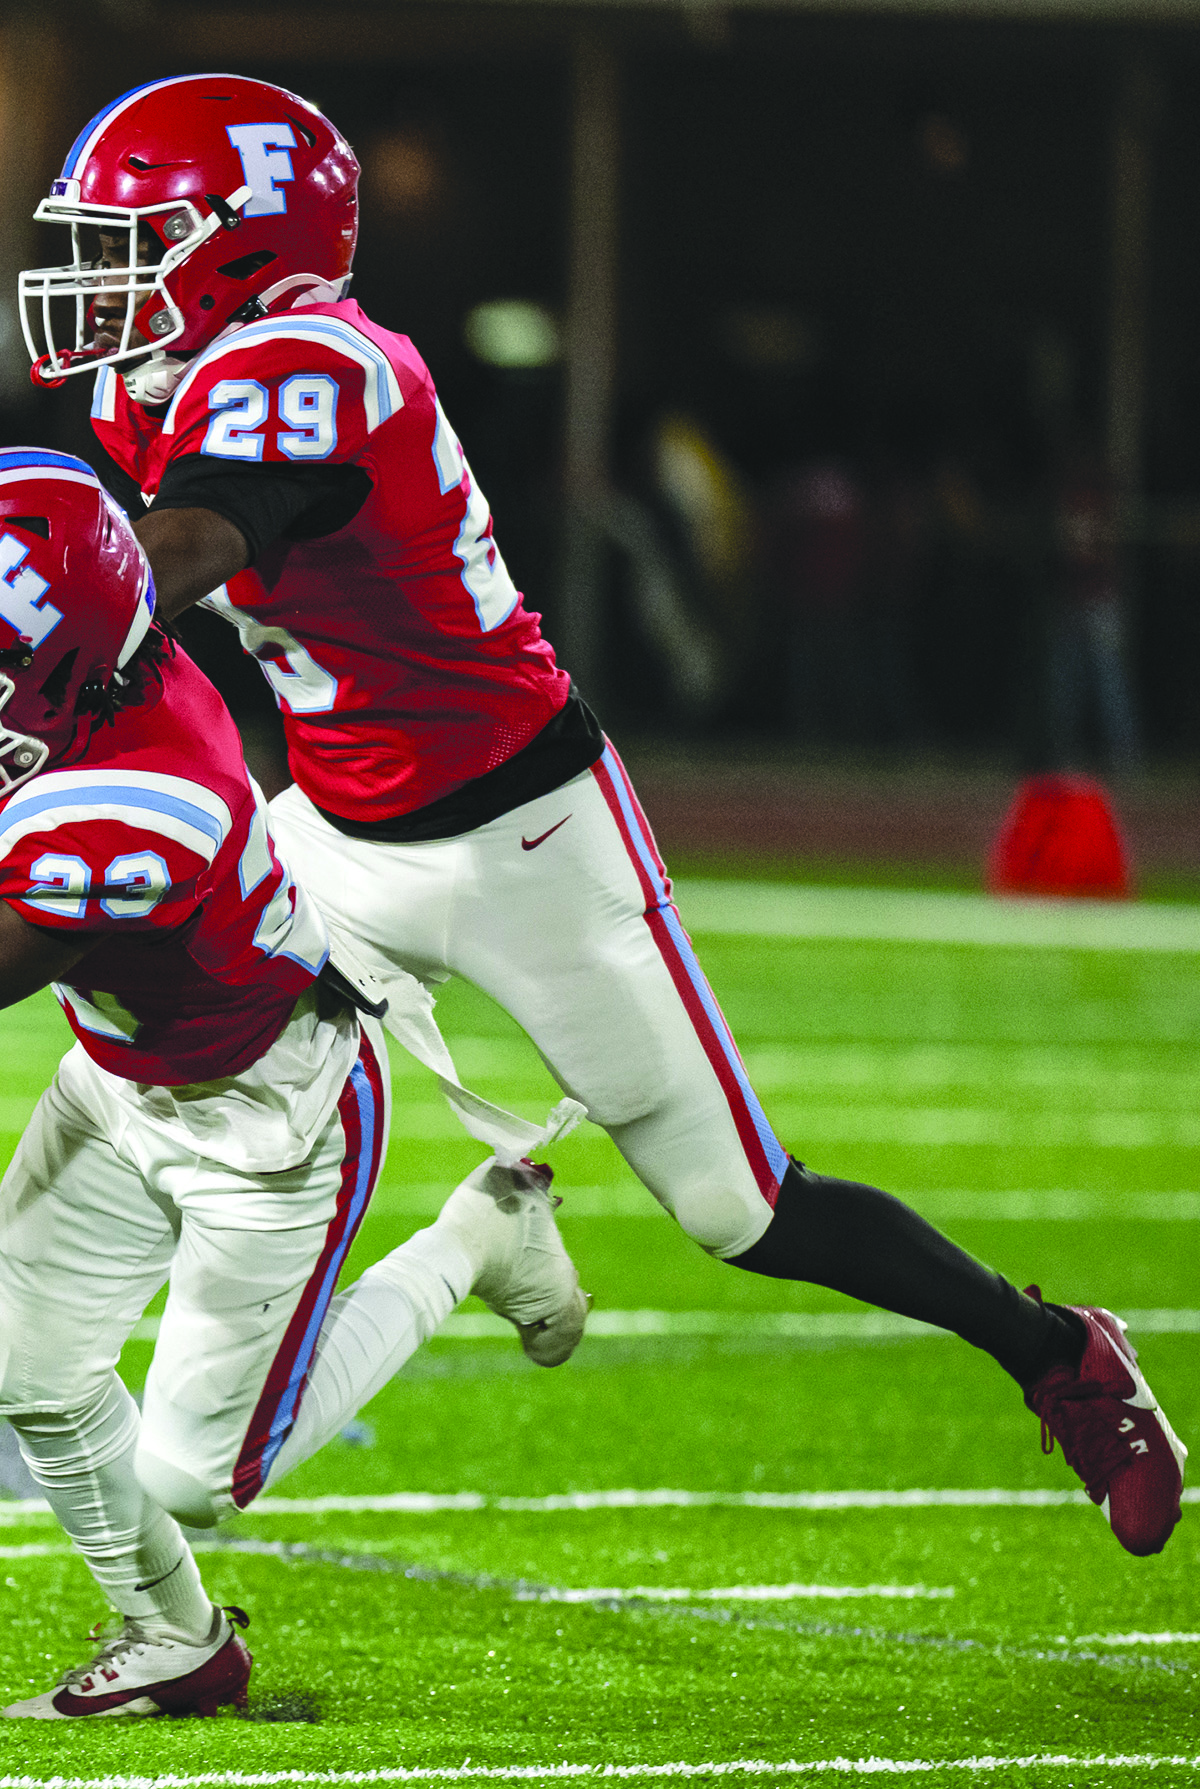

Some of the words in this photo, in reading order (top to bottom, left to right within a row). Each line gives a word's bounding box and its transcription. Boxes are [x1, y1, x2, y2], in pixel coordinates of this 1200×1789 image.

[226, 123, 298, 218] F
[201, 374, 339, 461] 29
[20, 850, 172, 919] 23
